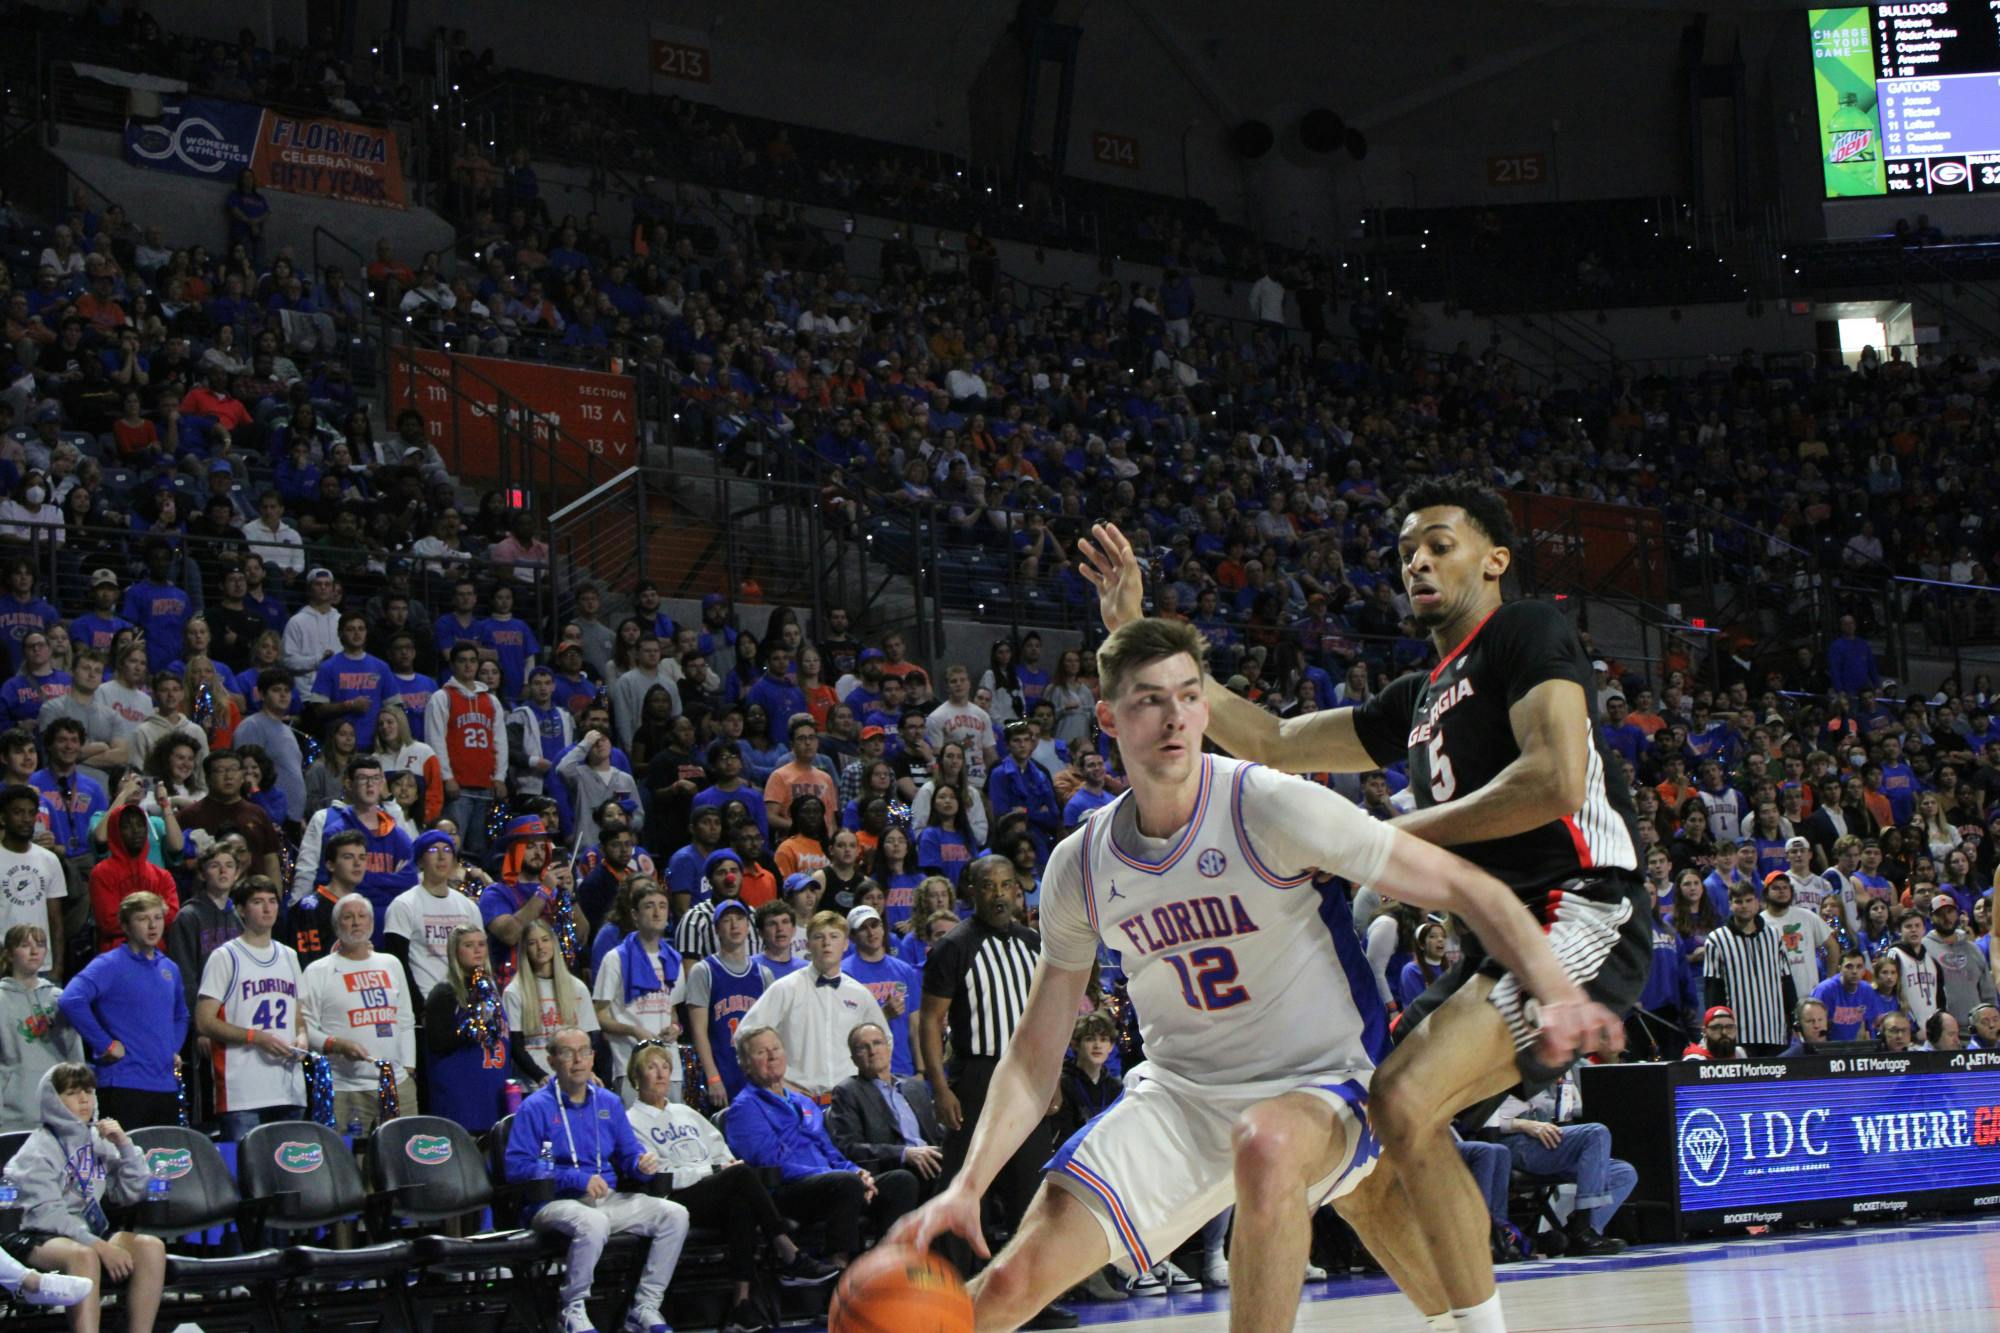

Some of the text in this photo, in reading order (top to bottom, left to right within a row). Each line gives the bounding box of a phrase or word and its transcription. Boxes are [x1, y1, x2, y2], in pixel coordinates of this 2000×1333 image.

[1879, 3, 1948, 17] BULLDOGS
[1894, 18, 1933, 29] Roberts
[1813, 27, 1868, 39] CHARGE
[1881, 32, 1887, 42] 1
[1833, 38, 1868, 48] YOUR
[1880, 44, 1889, 53] 3
[661, 46, 703, 77] 213
[1815, 48, 1852, 58] GAME
[1881, 56, 1890, 65] 5
[1882, 66, 1915, 77] 11 Hill
[1887, 81, 1941, 94] GATORS
[1902, 97, 1932, 106] Jones
[1887, 107, 1941, 119] 5 Richard
[1888, 120, 1936, 131] 11 Lofton
[185, 135, 241, 153] WOMEN'S
[271, 117, 387, 166] FLORIDA
[1888, 133, 1901, 143] 12
[185, 144, 249, 163] ATHLETICS
[1098, 136, 1135, 165] 214
[1906, 144, 1944, 154] Reeves
[281, 150, 375, 177] CELEBRATNG
[1495, 157, 1539, 181] 215
[1914, 162, 1922, 172] 7
[271, 161, 323, 195] FIFTY
[327, 168, 386, 201] YEARS
[1888, 178, 1925, 190] TOL 3
[428, 385, 448, 403] 111
[578, 385, 627, 401] SECTION
[580, 404, 604, 421] 113
[431, 420, 443, 437] 11
[588, 438, 604, 455] 13
[457, 712, 493, 729] FLORIDA
[1407, 677, 1475, 749] GERGIA
[463, 728, 489, 749] 23
[1428, 726, 1458, 804] 5
[1119, 894, 1260, 956] FLORIDA
[352, 971, 386, 991] JUST
[1162, 946, 1252, 1012] 12
[241, 978, 299, 1001] FLORIDA
[363, 988, 385, 1008] US
[252, 998, 288, 1031] 42
[482, 1041, 506, 1069] 13
[1699, 1063, 1787, 1079] ROCKET Mortgage
[1740, 1108, 1829, 1161] IDC
[1850, 1109, 1973, 1154] WHERE
[1853, 1200, 1908, 1213] ROCKET Mortgage
[1723, 1210, 1783, 1225] ROCKET Mortgage
